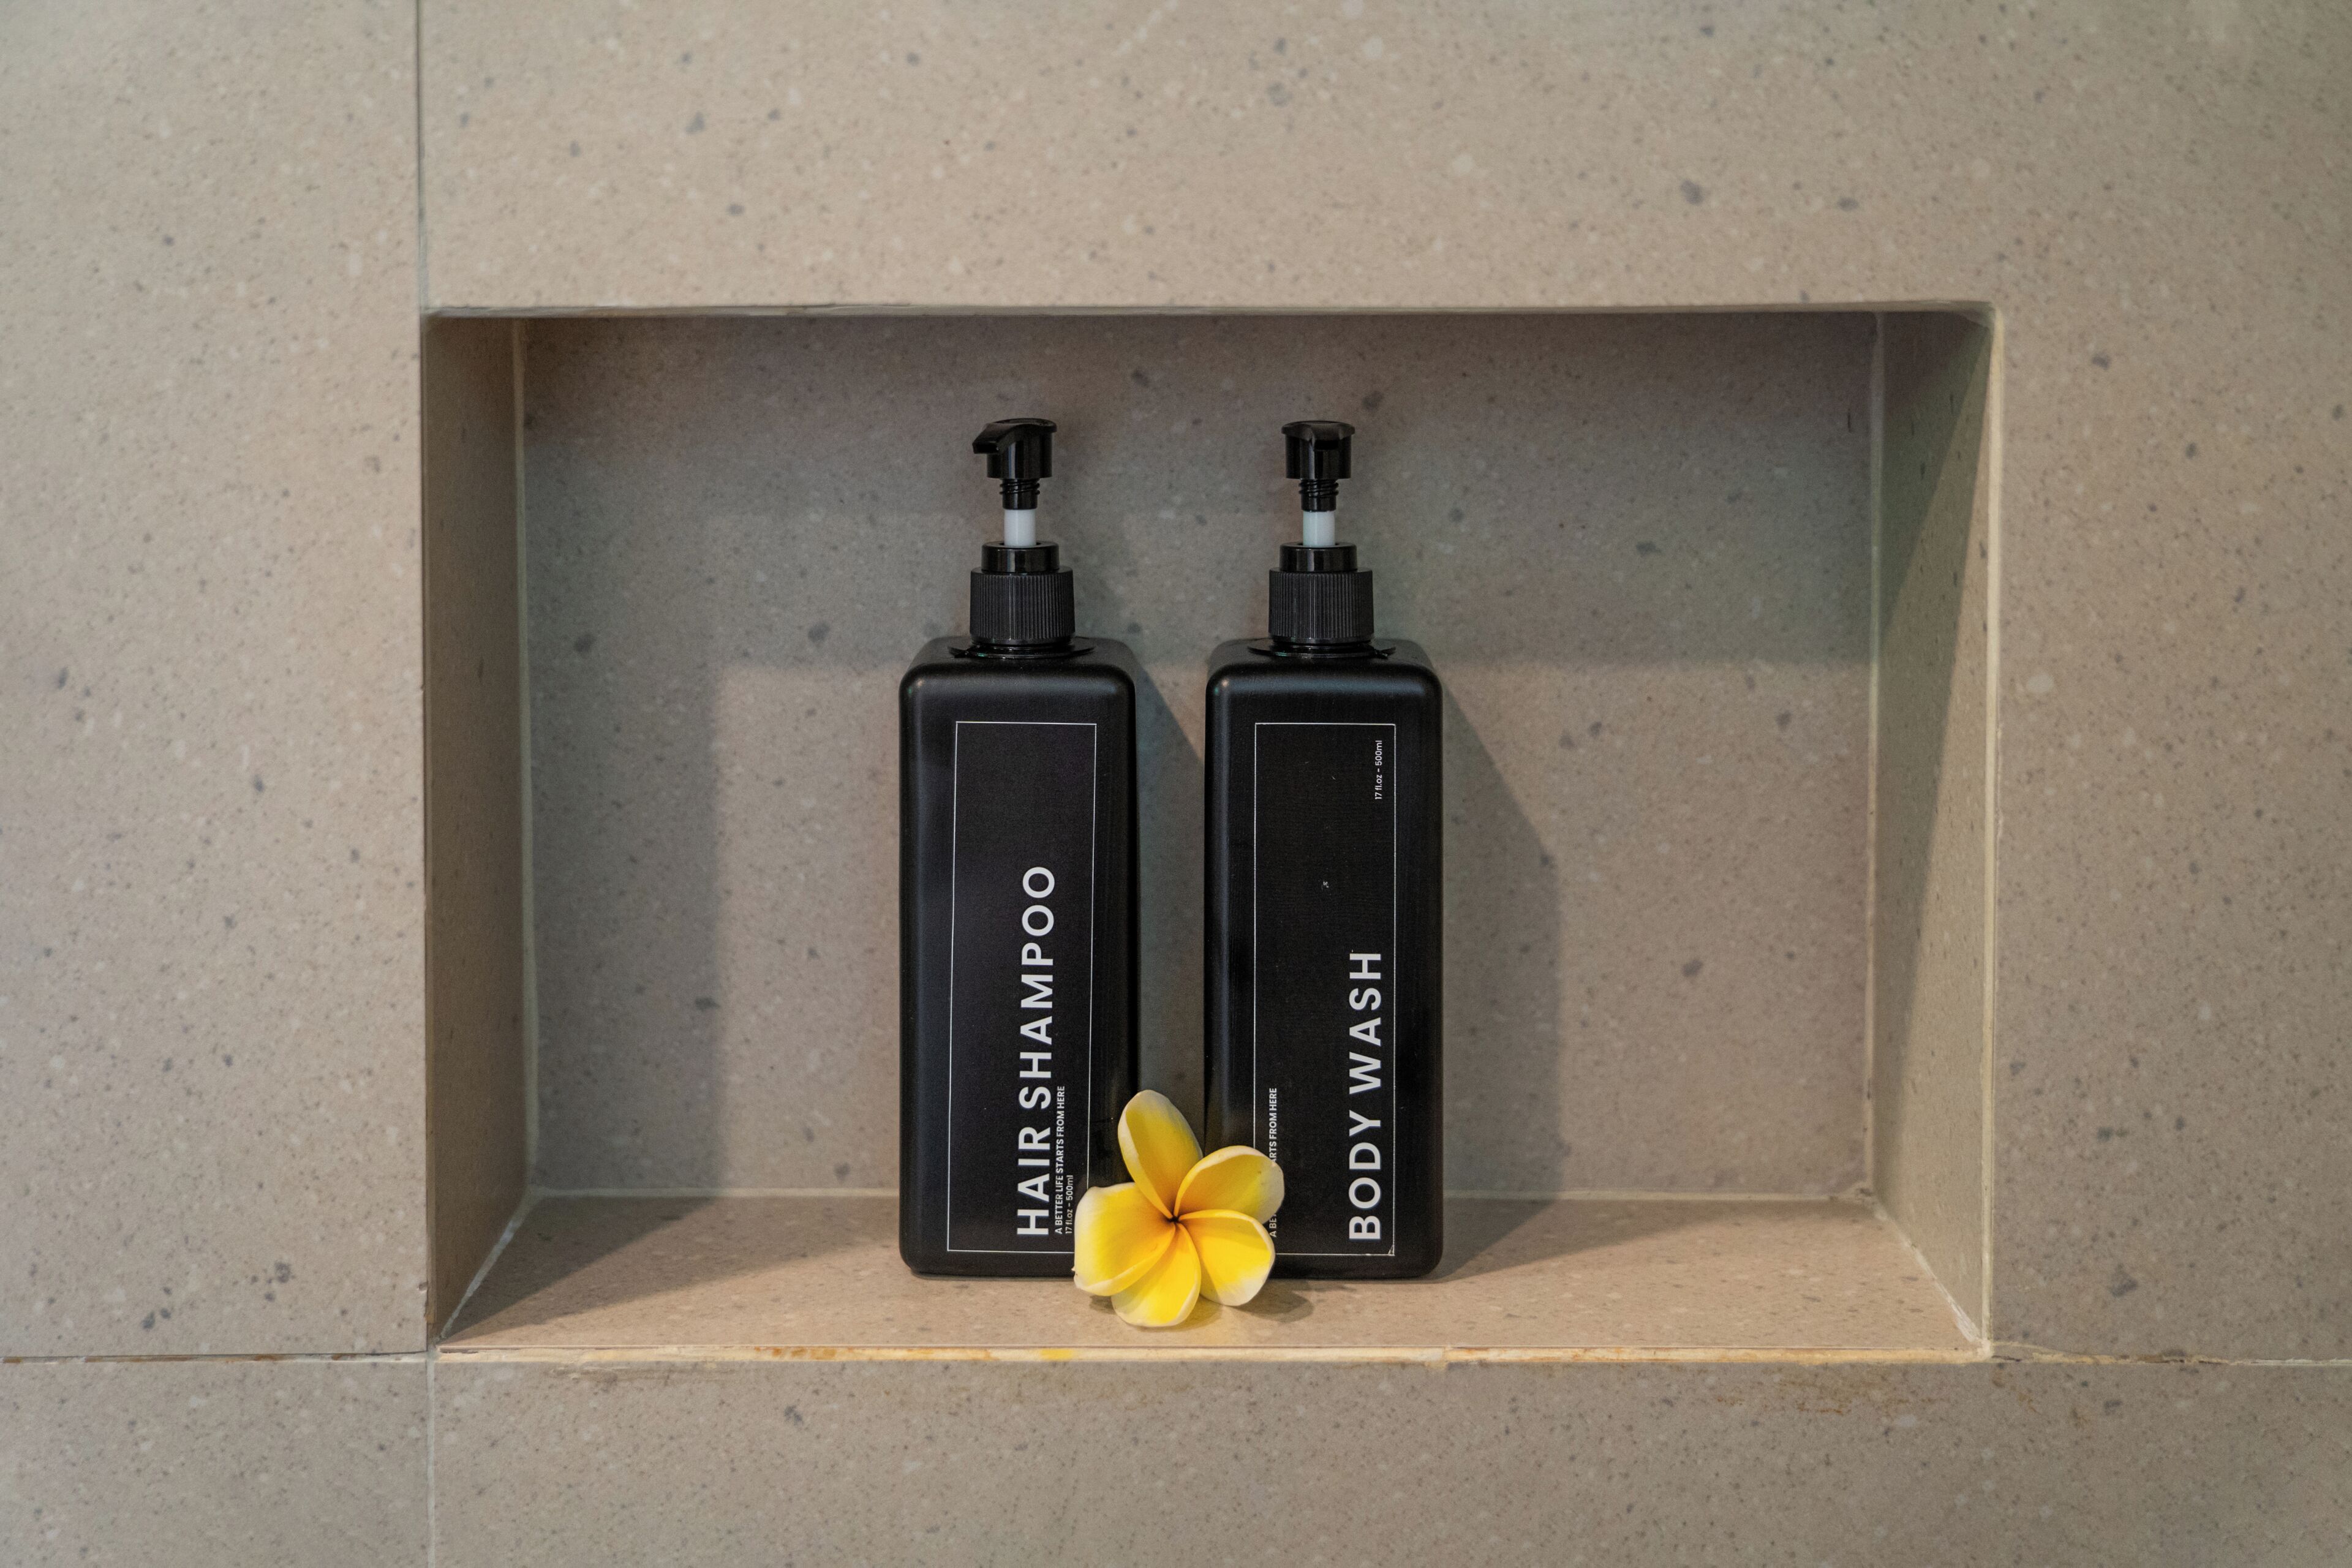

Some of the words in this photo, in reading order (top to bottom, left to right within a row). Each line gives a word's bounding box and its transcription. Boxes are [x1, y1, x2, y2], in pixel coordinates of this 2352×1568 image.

[1018, 866, 1055, 1109] SHAMPOO
[1349, 952, 1382, 1094] WASH
[1057, 1086, 1065, 1109] HERE
[1268, 1088, 1277, 1110] HERE
[1056, 1110, 1065, 1137] FROM
[1268, 1112, 1277, 1139] FROM
[1056, 1139, 1065, 1174] STARTS
[1017, 1126, 1051, 1235] HAIR
[1055, 1175, 1064, 1192] LIFE
[1349, 1109, 1381, 1240] BODY
[1055, 1194, 1063, 1225] BETTER
